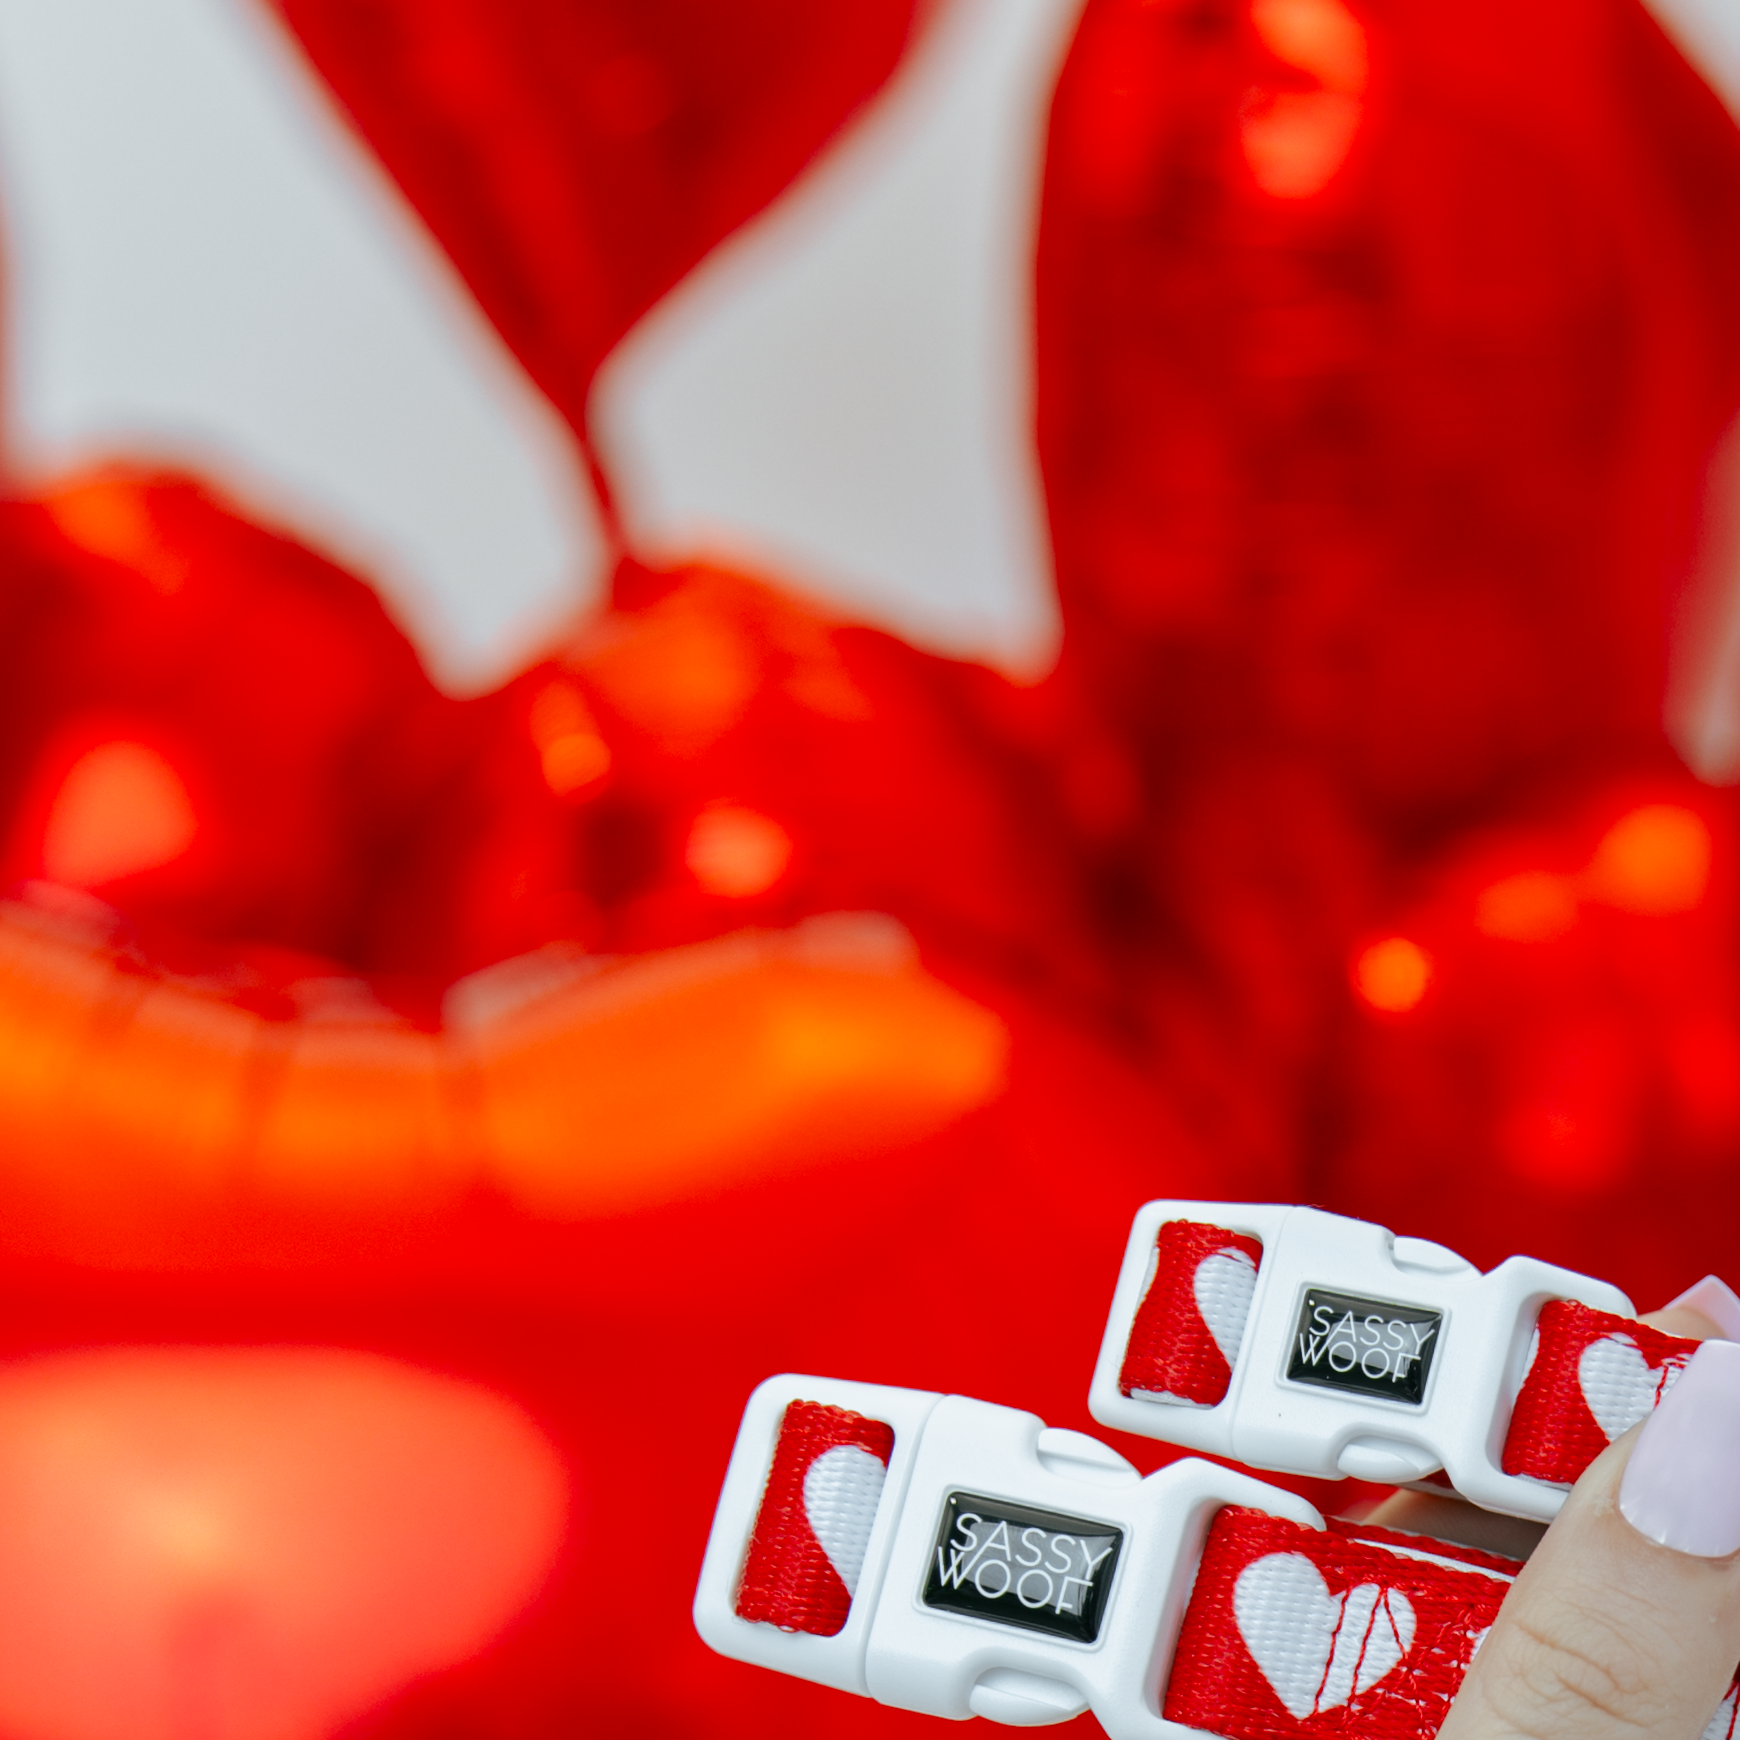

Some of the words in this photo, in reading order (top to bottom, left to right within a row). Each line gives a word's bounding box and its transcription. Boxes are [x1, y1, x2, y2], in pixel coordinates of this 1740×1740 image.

[1300, 1332, 1421, 1383] WOOF
[1309, 1306, 1435, 1355] SASSY
[950, 1513, 1113, 1580] SASSY
[937, 1546, 1094, 1615] WOOF
